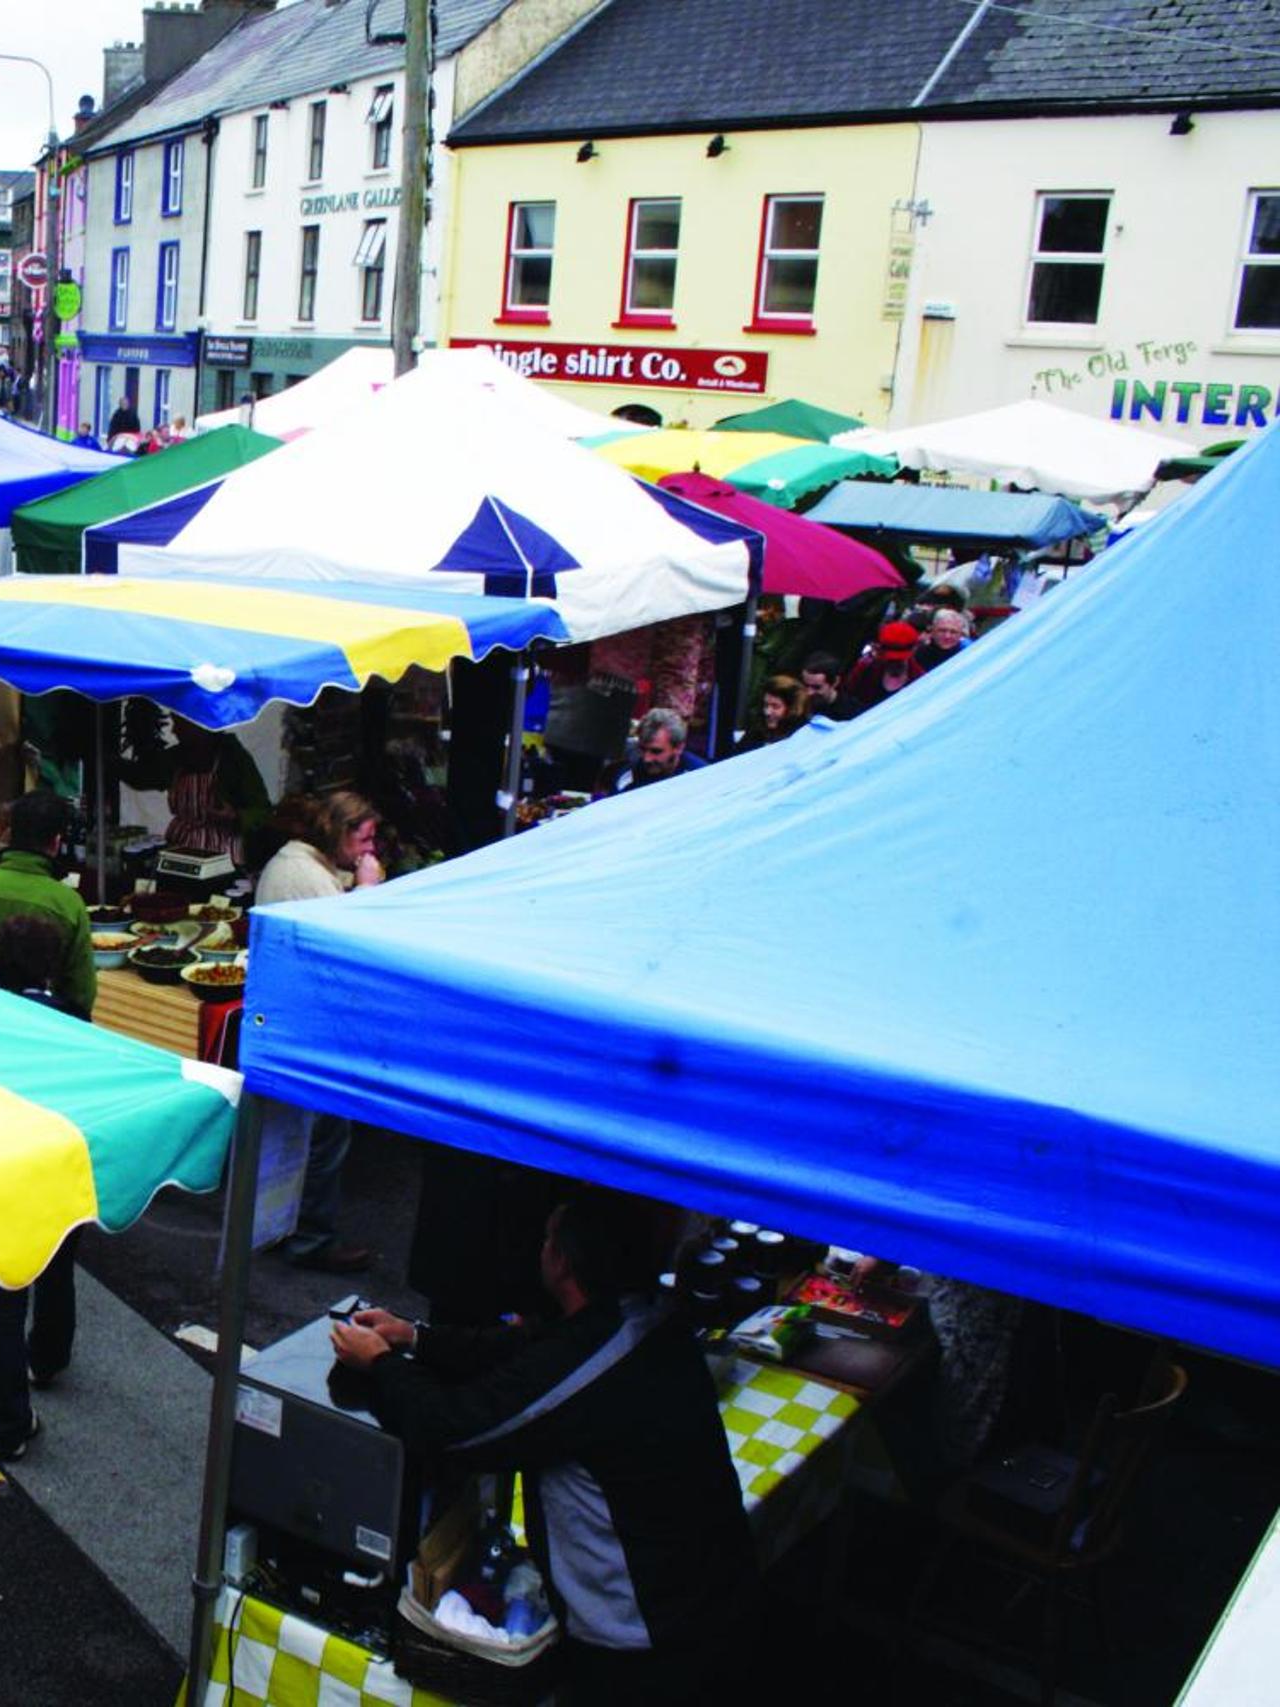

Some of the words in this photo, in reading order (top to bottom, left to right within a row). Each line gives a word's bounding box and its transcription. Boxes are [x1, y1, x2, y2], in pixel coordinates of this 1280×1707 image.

[476, 343, 558, 378] ingle
[564, 348, 634, 379] shirt
[641, 352, 687, 381] Co.
[1036, 367, 1082, 393] The
[1087, 351, 1129, 377] Old
[1110, 378, 1280, 428] INTER
